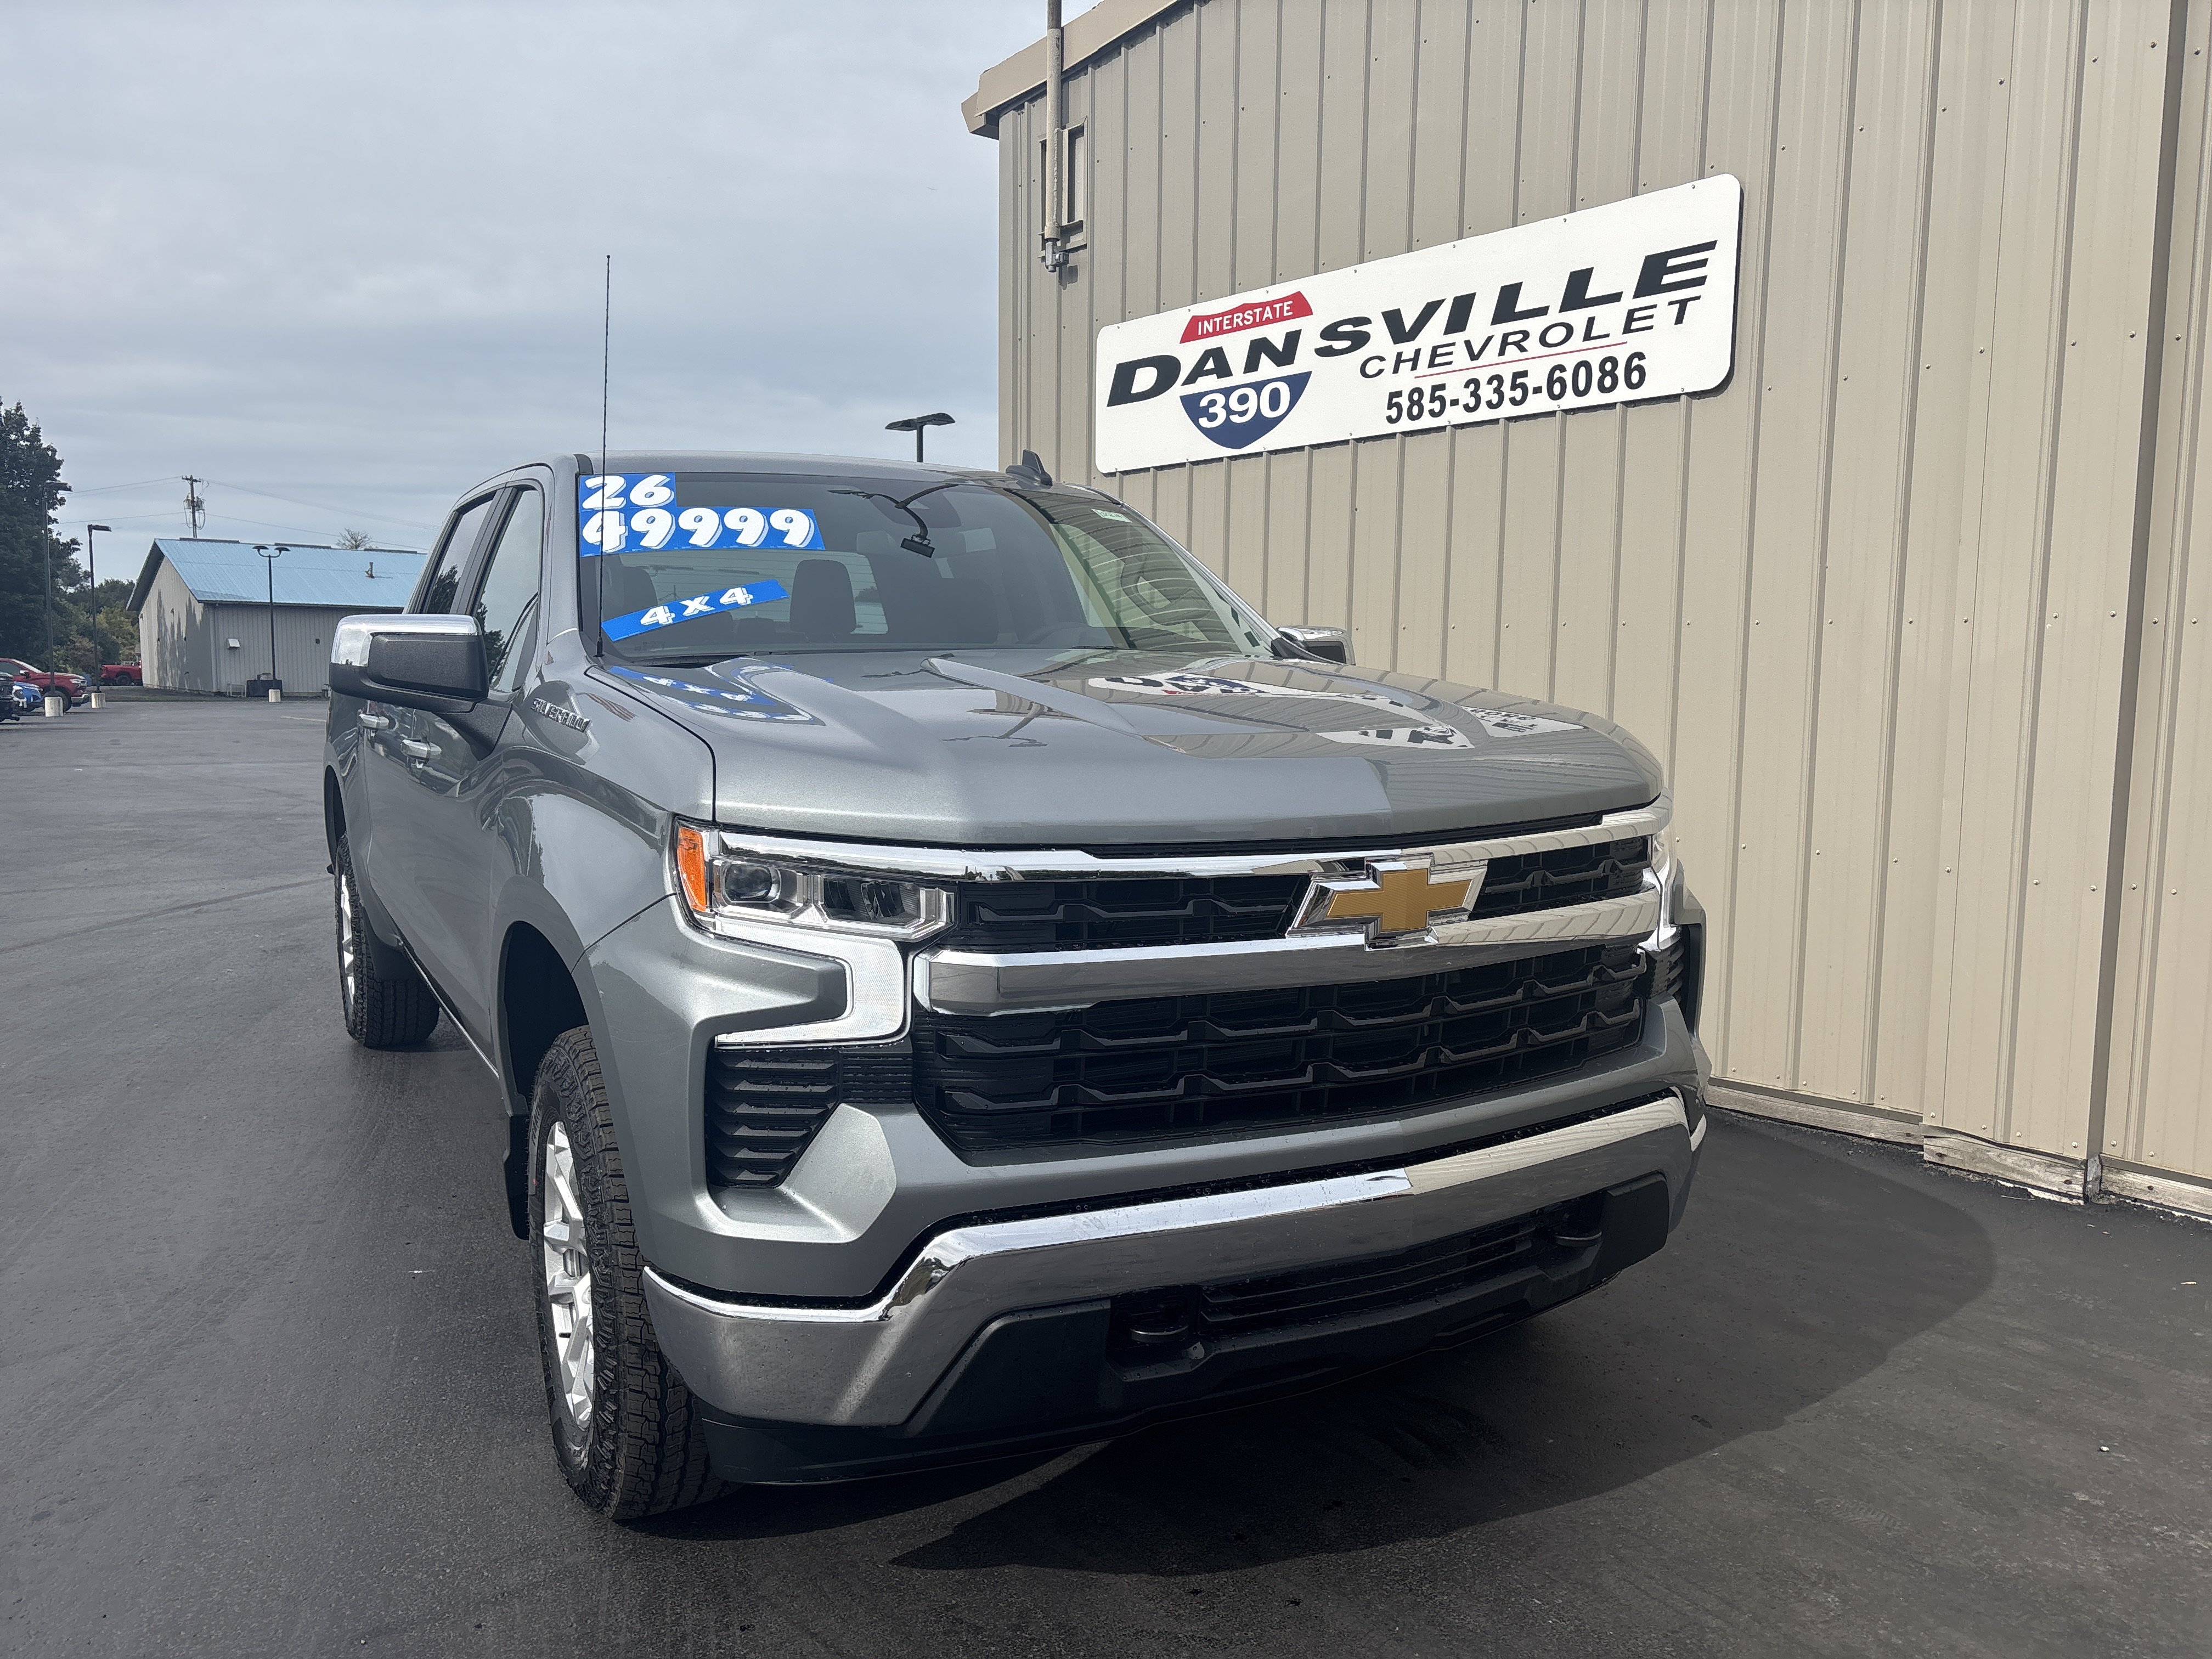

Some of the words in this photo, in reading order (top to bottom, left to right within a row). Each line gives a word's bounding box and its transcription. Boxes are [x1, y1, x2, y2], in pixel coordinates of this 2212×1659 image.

[1197, 300, 1294, 336] INTERSTATE
[1359, 295, 1701, 379] CHEVROLET
[1198, 381, 1290, 428] 390
[1386, 351, 1647, 424] 585-335-6086
[582, 475, 675, 510] 26
[582, 507, 814, 553] 49999
